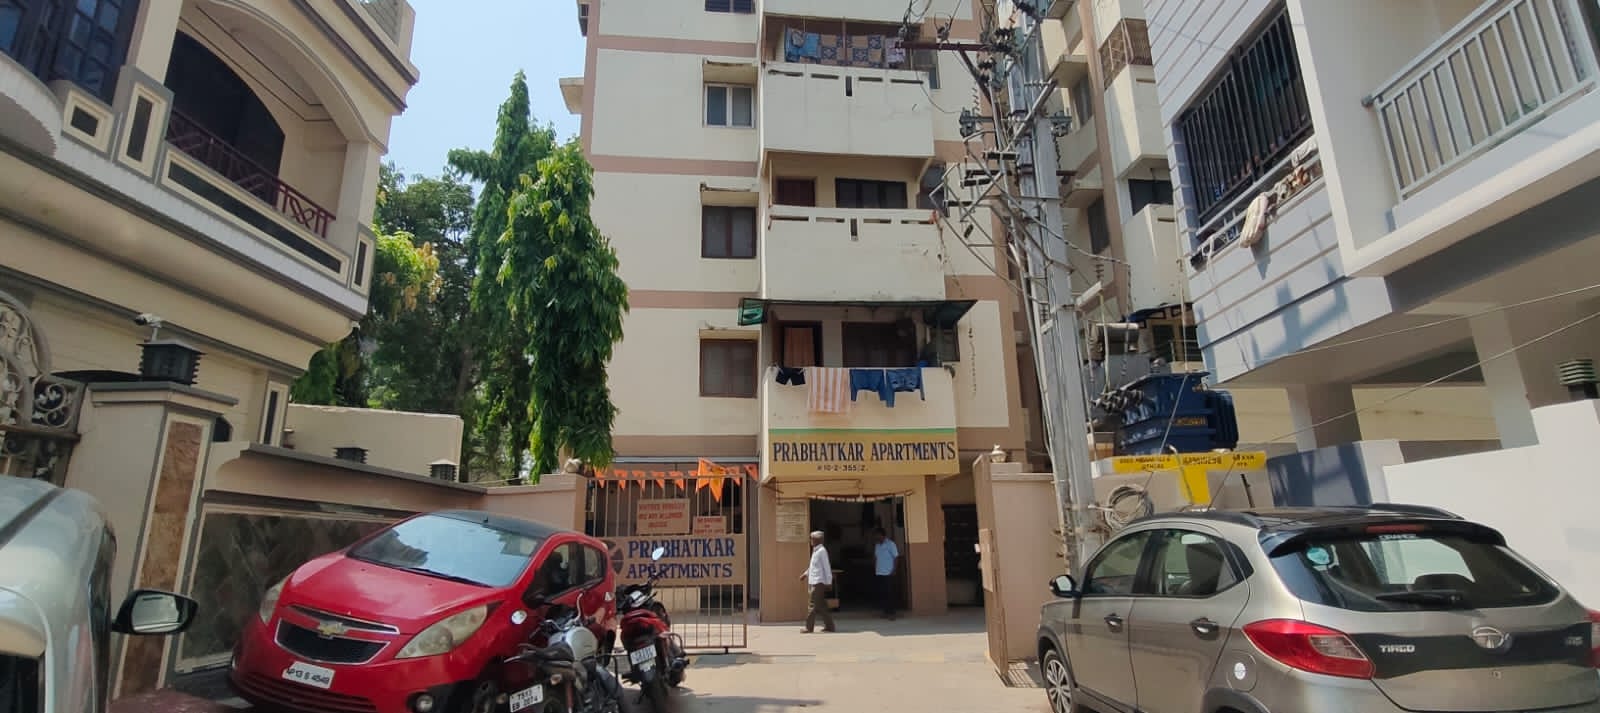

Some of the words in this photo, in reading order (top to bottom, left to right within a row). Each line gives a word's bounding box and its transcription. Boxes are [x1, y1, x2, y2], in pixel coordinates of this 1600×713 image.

[773, 442, 865, 462] PRABHATKAR
[870, 441, 956, 461] APARTMENTS
[628, 539, 735, 558] PRABHATKAR
[1379, 644, 1415, 653] TIAGO
